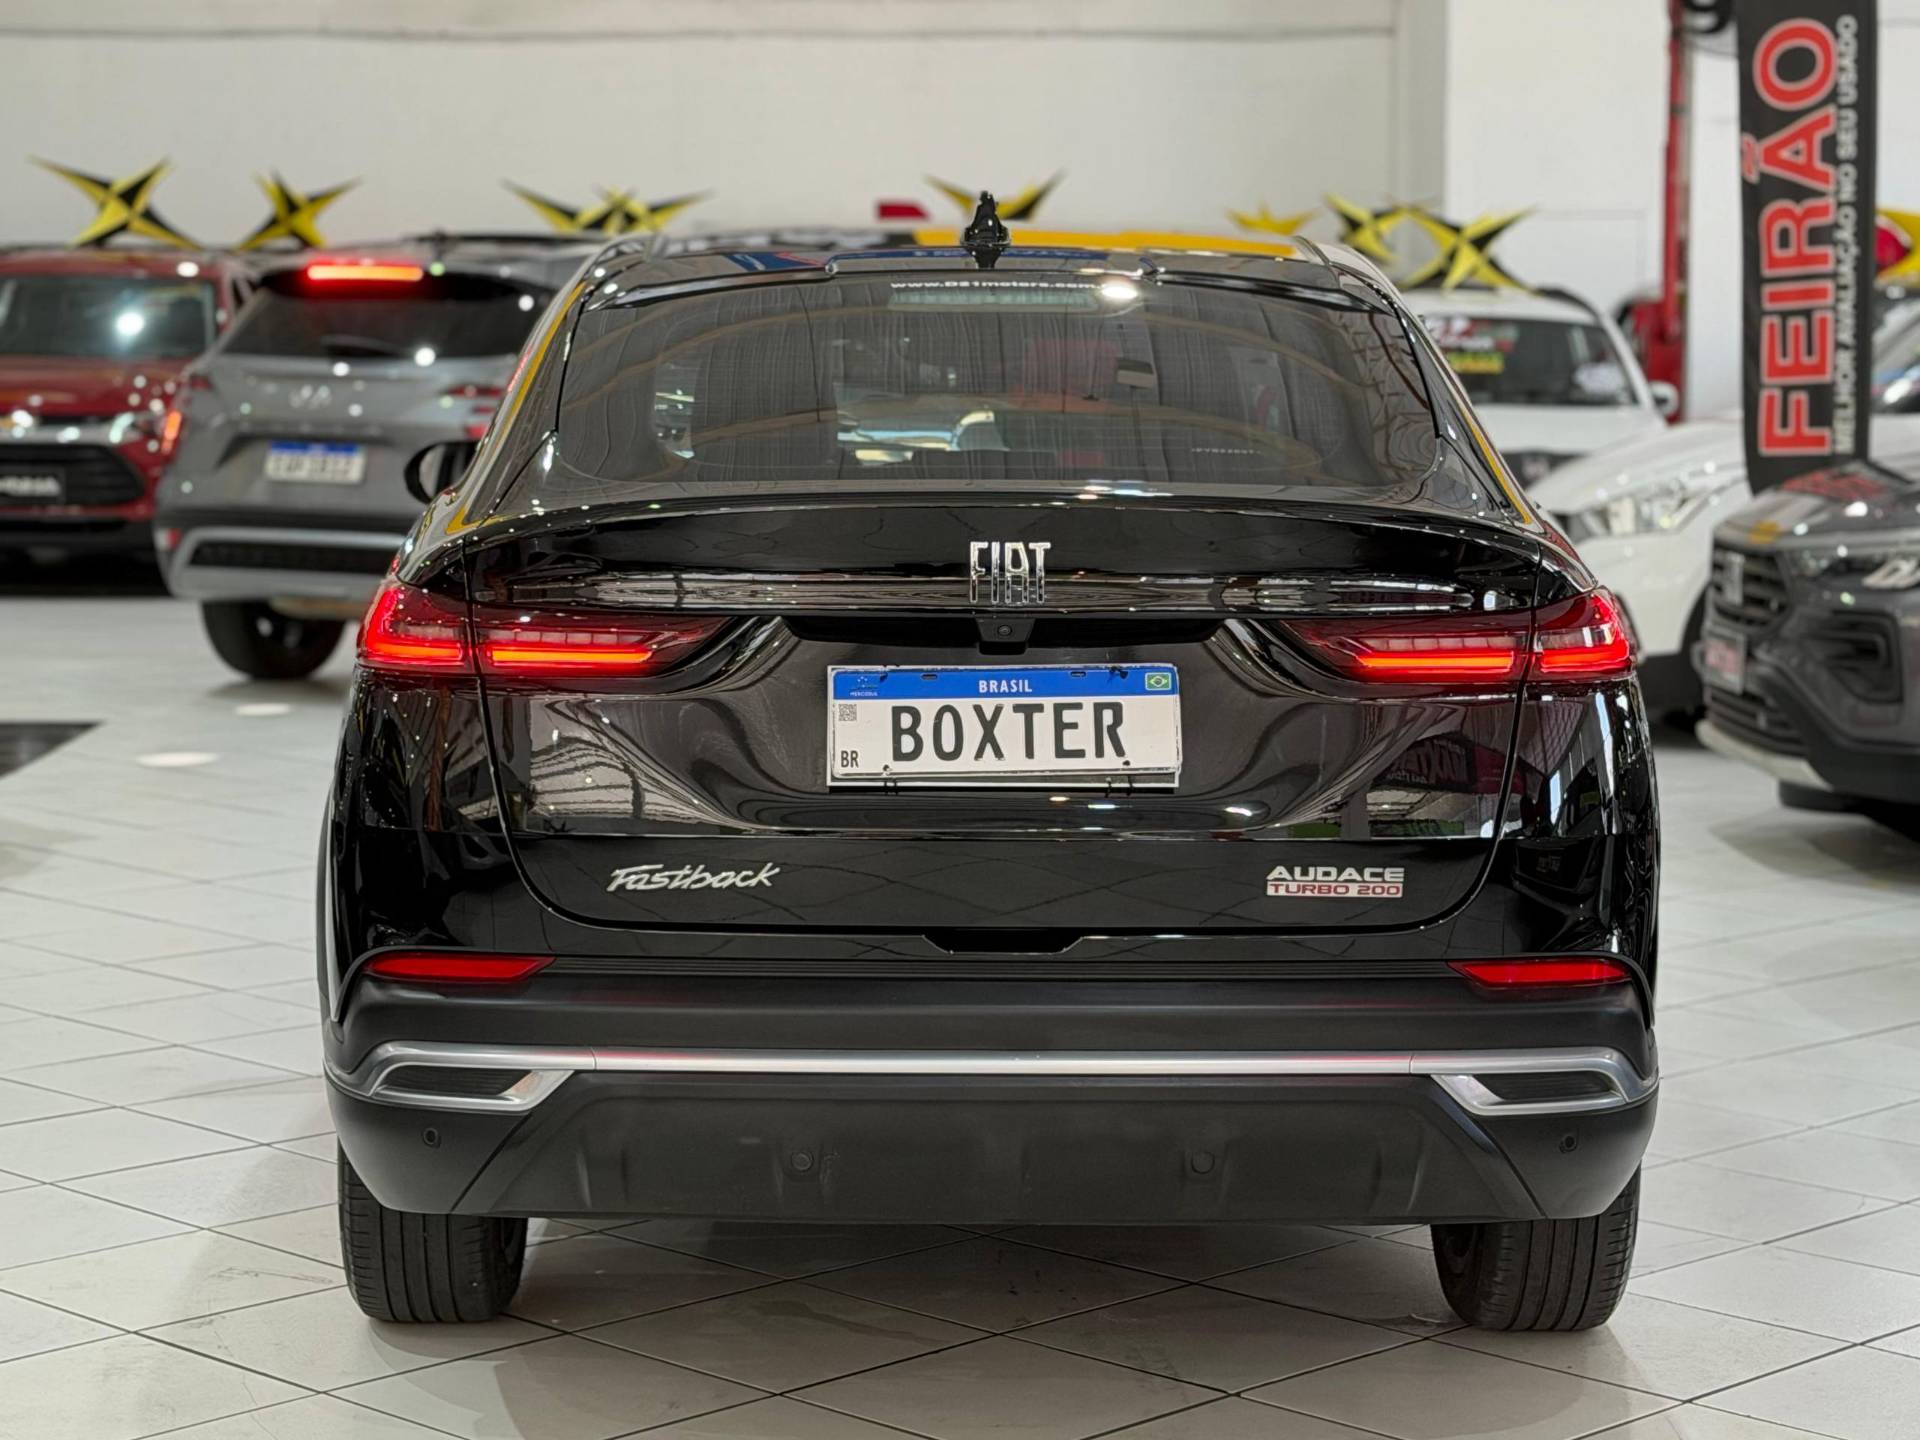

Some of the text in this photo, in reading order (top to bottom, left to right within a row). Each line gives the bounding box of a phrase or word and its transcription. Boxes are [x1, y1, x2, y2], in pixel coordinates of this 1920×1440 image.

[1742, 17, 1839, 457] FEIRÃO
[1834, 15, 1859, 454] MELHOR AVALIAÇÃO NO SEU USADO
[970, 541, 1051, 604] FIAT
[979, 680, 1032, 693] BRASIL
[890, 701, 1127, 762] BOXTER
[840, 750, 859, 768] BR
[606, 861, 781, 892] Fastback
[1266, 865, 1405, 882] AUDACE
[1269, 883, 1401, 896] TURBO 200
